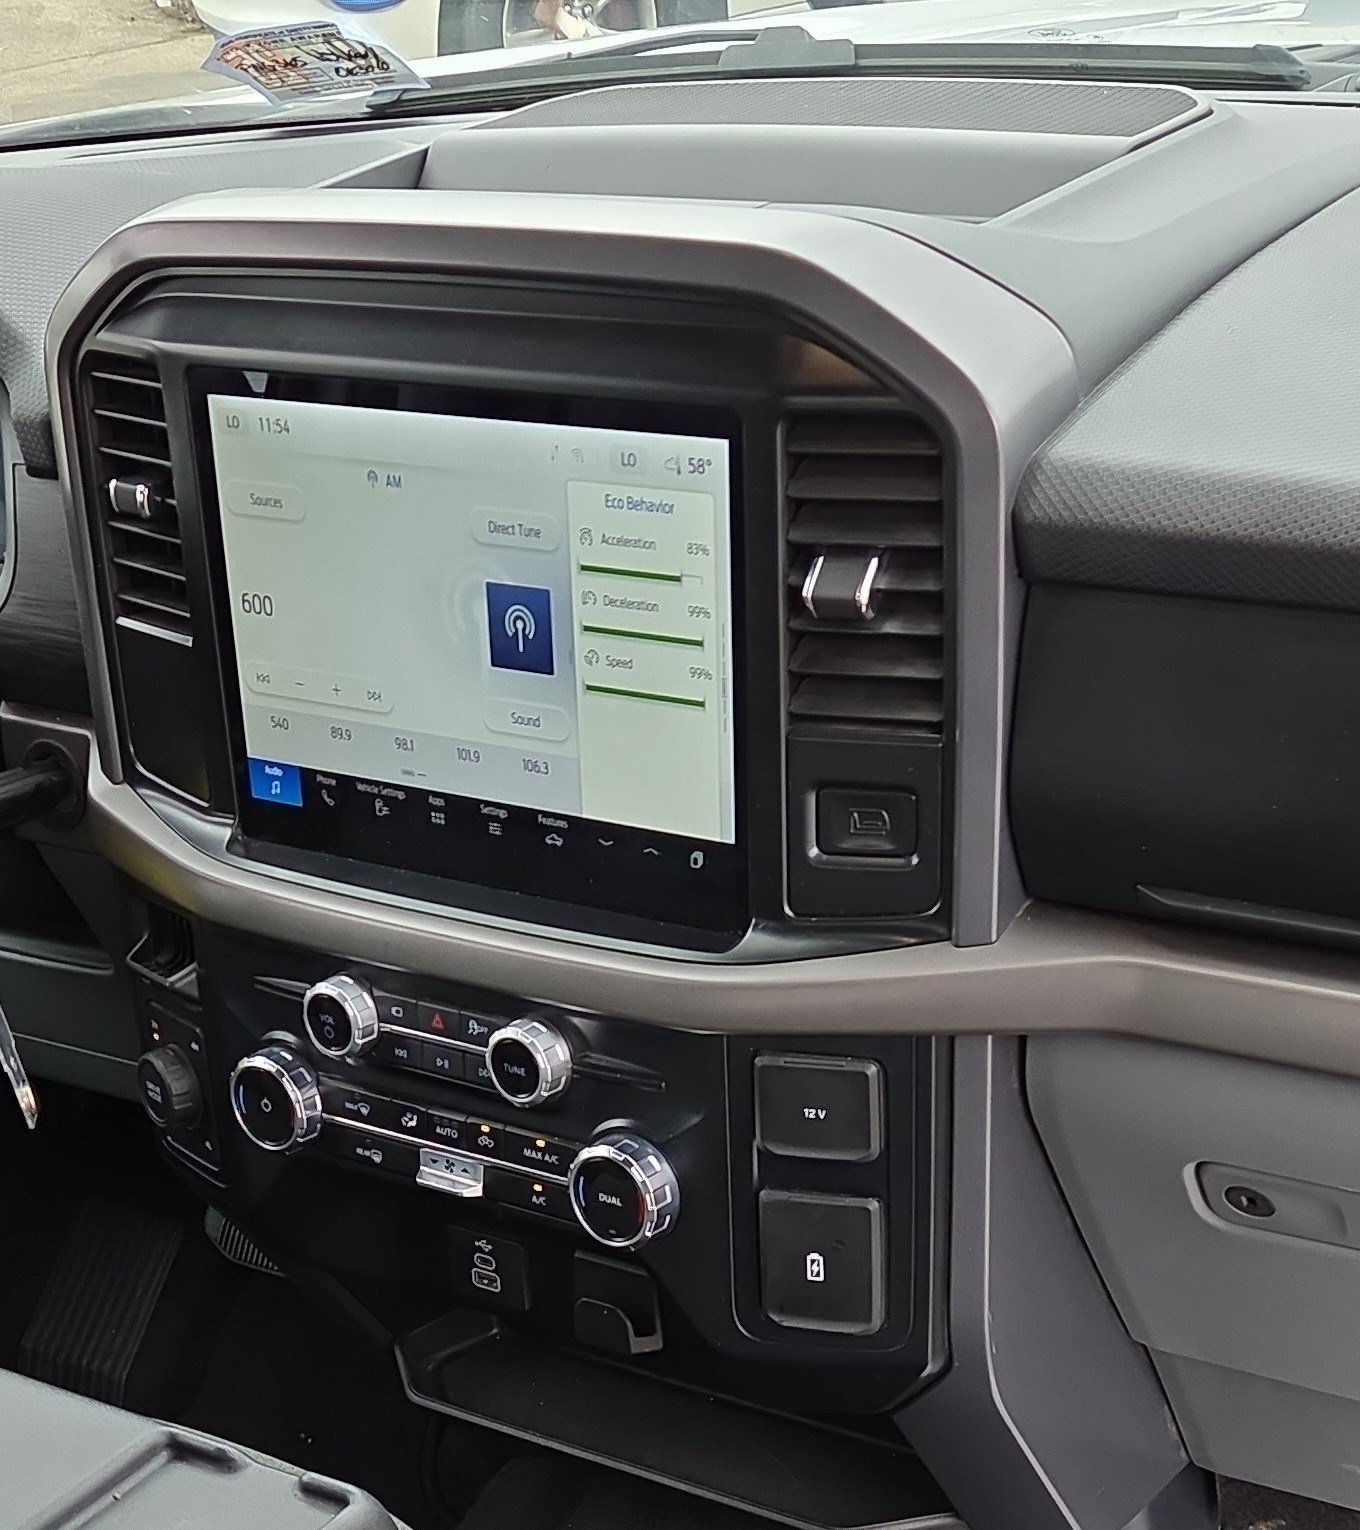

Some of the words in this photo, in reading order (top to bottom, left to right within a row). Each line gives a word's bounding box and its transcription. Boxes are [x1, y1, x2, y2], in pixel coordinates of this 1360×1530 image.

[226, 414, 240, 430] LO
[258, 416, 290, 434] 11:54
[620, 451, 638, 468] LO
[385, 474, 402, 489] AM
[249, 492, 284, 509] Sources
[603, 493, 625, 510] Eco
[626, 495, 675, 515] Behavior
[487, 520, 517, 537] Direct
[517, 523, 542, 540] Tune
[600, 534, 657, 552] Acceleration
[241, 592, 274, 617] 600
[603, 594, 659, 613] Deceleration
[605, 656, 634, 671] Speed
[510, 711, 542, 729] Sound
[270, 716, 289, 732] 540
[522, 758, 550, 776] 106.3
[503, 1063, 527, 1077] TUNE
[435, 1126, 458, 1139] AUTO
[523, 1148, 543, 1162] MAX
[543, 1152, 559, 1165] A/C
[598, 1192, 623, 1207] DUAL
